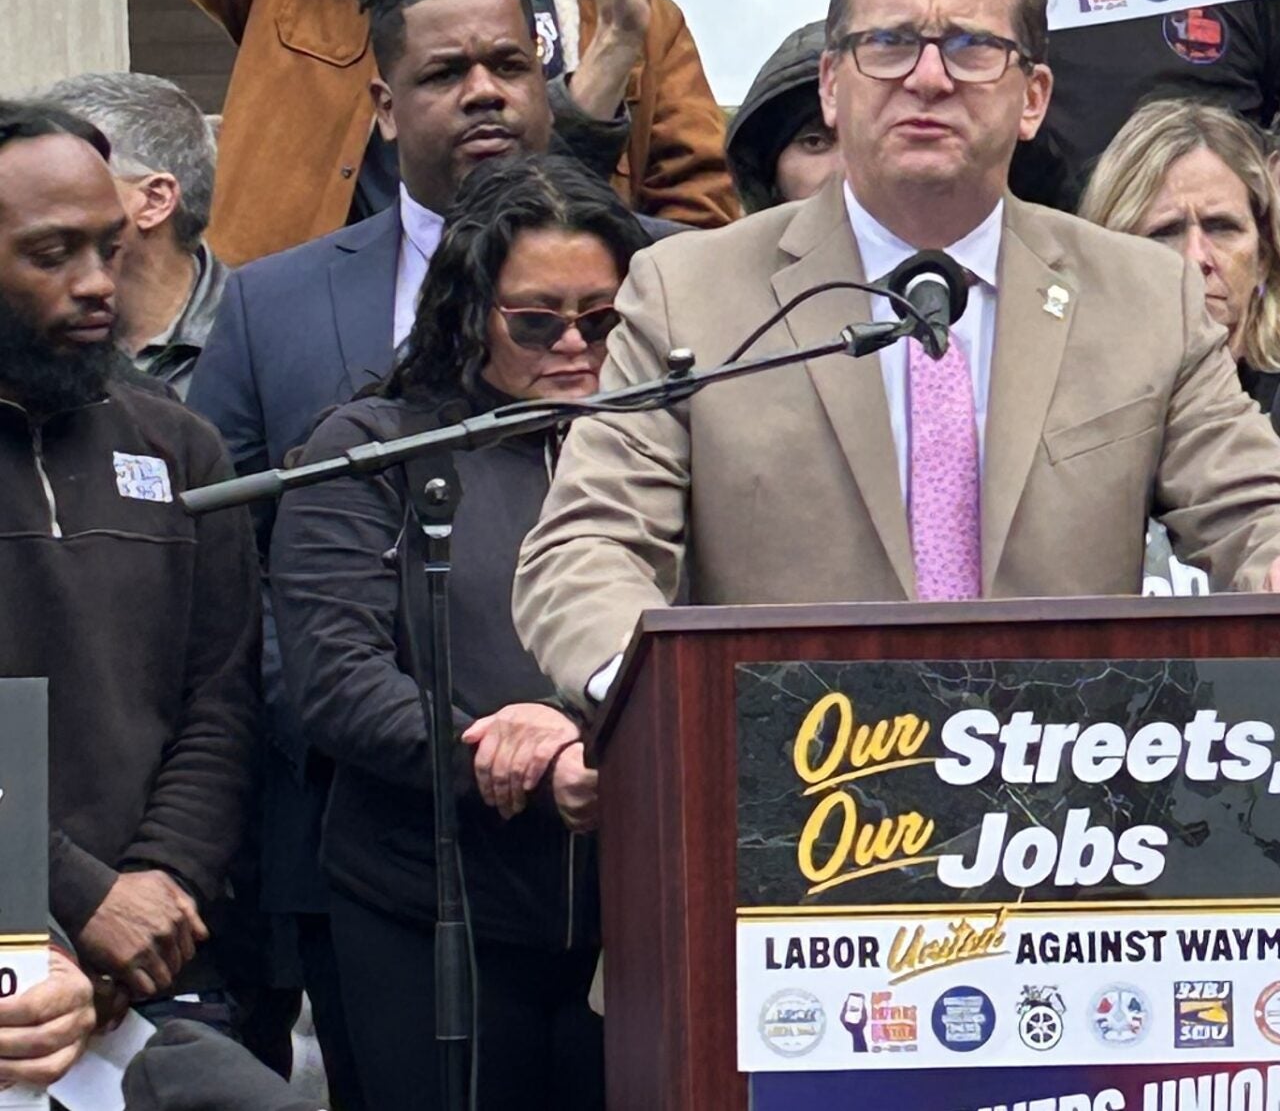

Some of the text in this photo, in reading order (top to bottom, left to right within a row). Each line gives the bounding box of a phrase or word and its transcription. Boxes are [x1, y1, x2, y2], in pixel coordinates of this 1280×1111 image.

[794, 691, 932, 790] Our
[798, 791, 1169, 889] Our Jobs
[765, 935, 880, 969] LABOR
[1015, 930, 1164, 965] AGAINST
